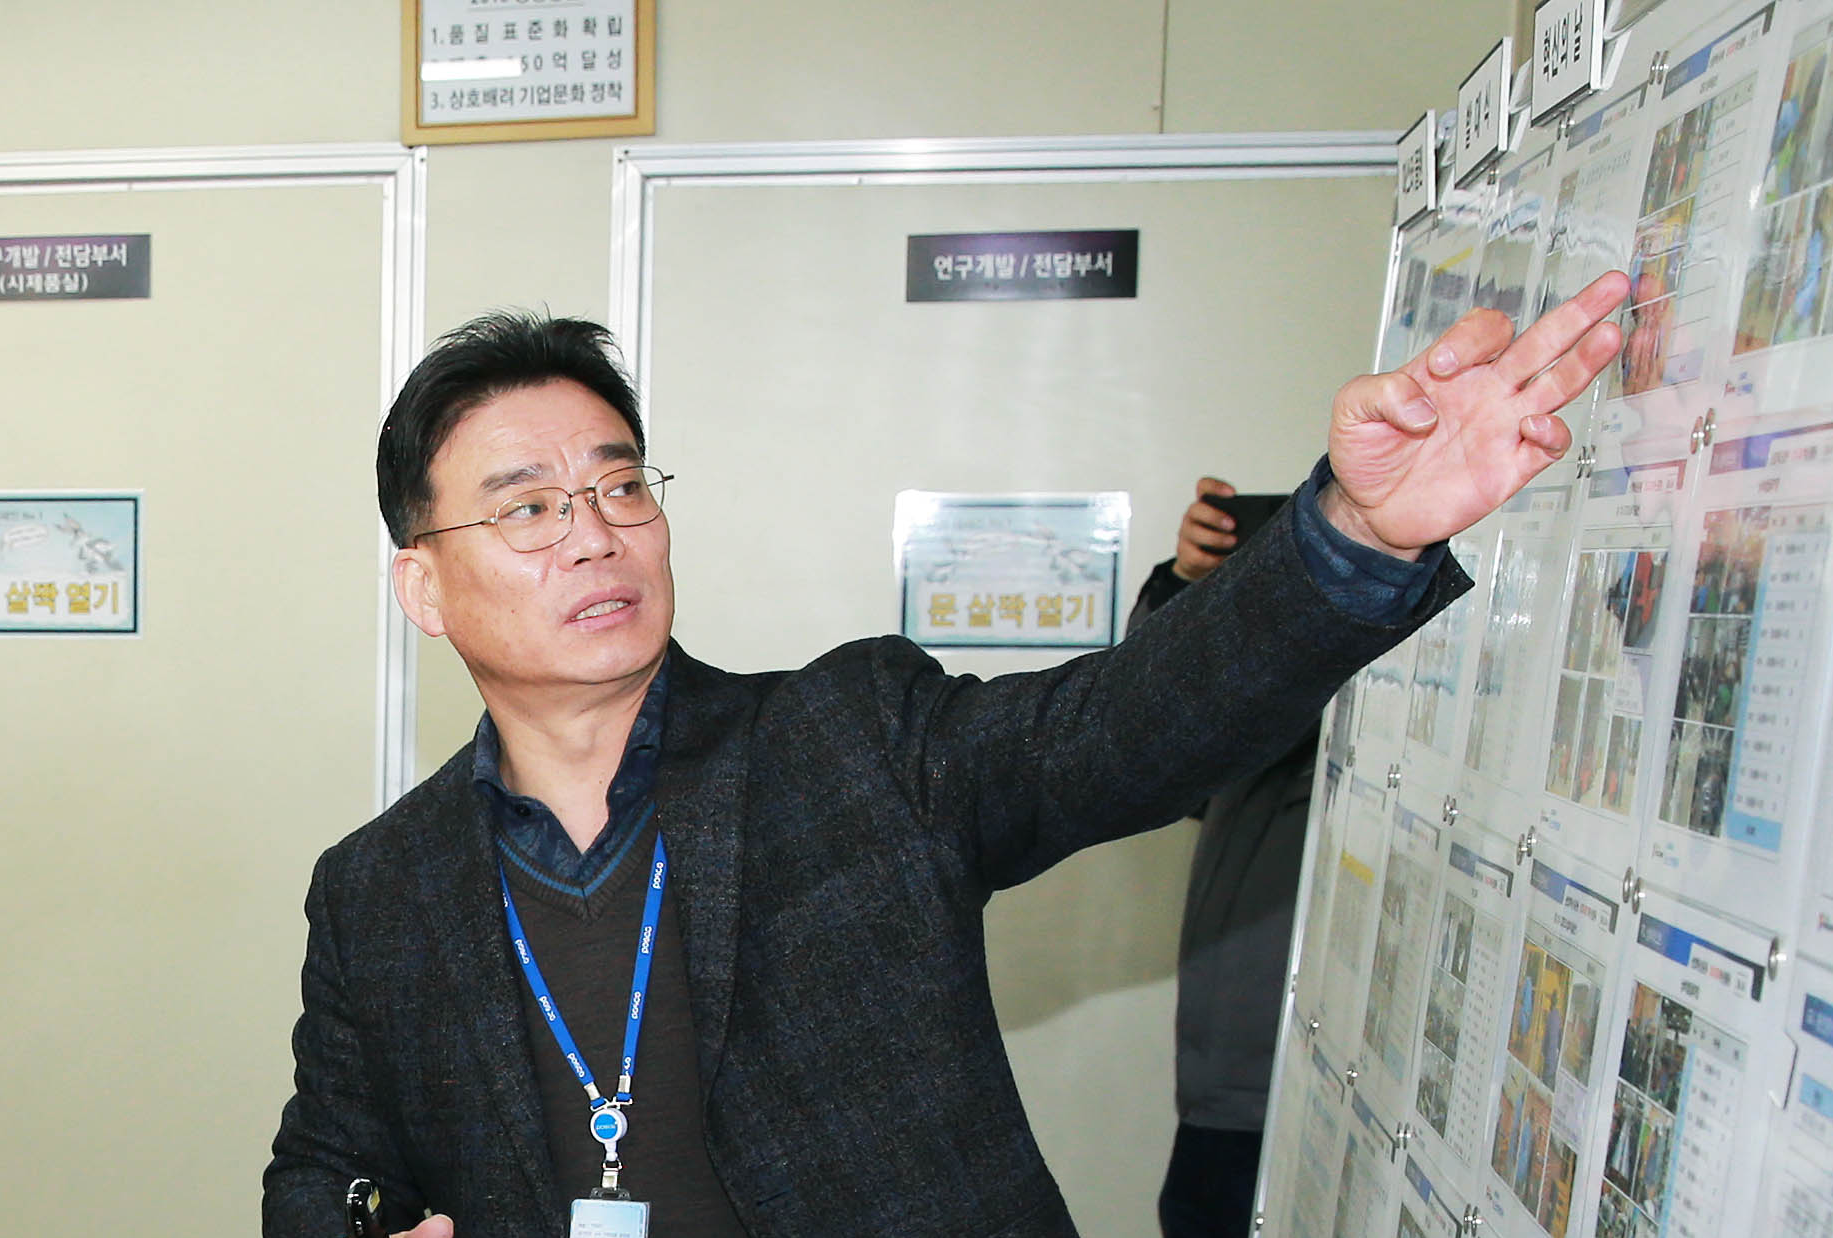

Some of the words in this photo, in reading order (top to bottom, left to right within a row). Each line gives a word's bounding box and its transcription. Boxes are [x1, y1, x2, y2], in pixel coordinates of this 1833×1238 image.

[431, 28, 444, 45] 1.
[449, 23, 490, 46] 품질
[502, 19, 568, 42] 표준화
[582, 16, 622, 38] 확립
[430, 91, 445, 110] 3.
[449, 88, 515, 111] 상호배려
[519, 84, 585, 106] 기업문화
[590, 81, 622, 103] 정착
[54, 243, 128, 268] 전담부서
[932, 252, 1015, 281] 연구개발
[1032, 251, 1114, 279] 전담부서
[65, 580, 119, 615] 열기
[928, 593, 959, 628] 문
[1034, 592, 1095, 629] 열기
[652, 861, 665, 889] posco
[641, 925, 654, 955] posco
[567, 1052, 586, 1078] posco
